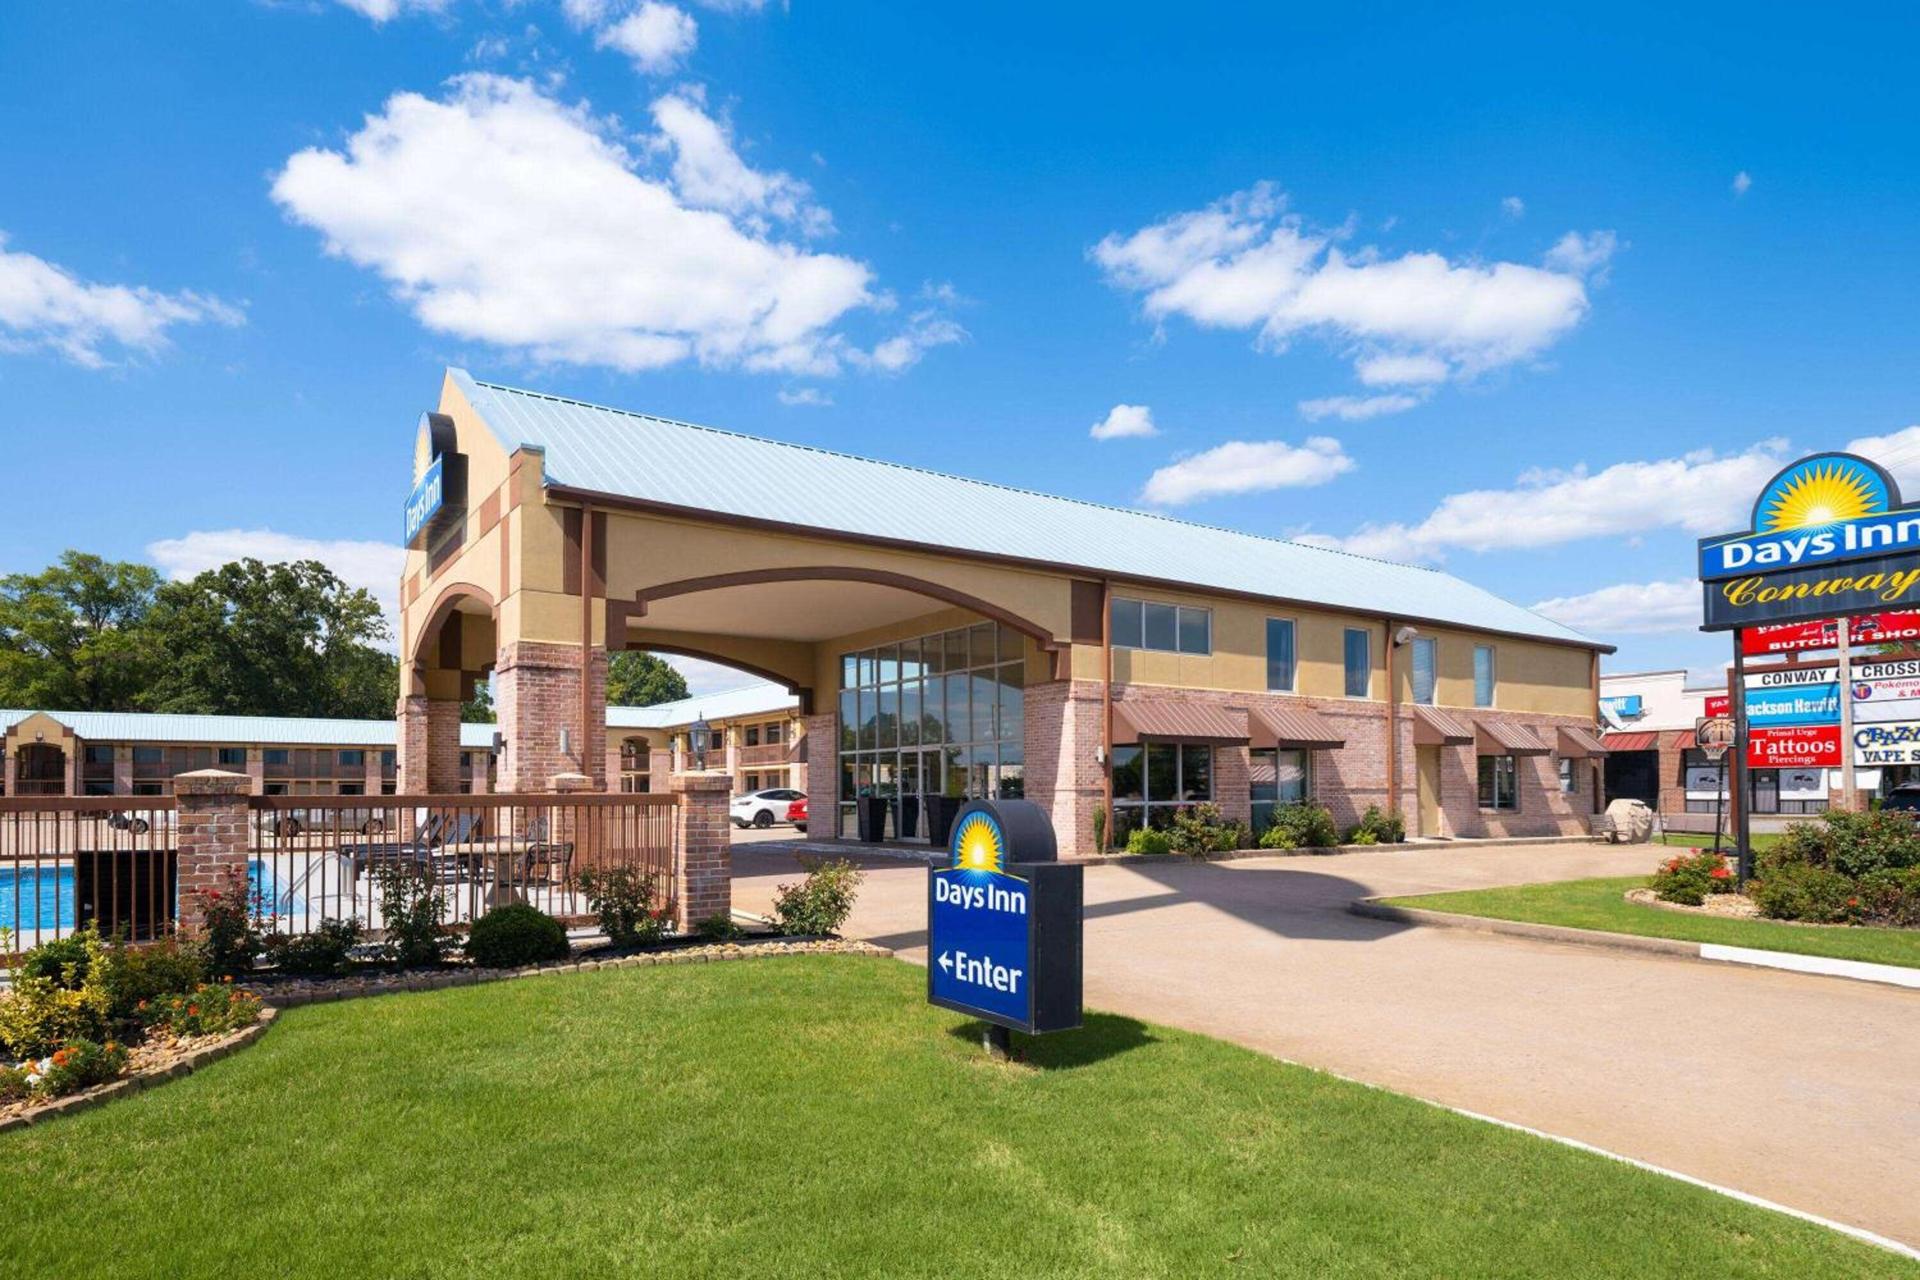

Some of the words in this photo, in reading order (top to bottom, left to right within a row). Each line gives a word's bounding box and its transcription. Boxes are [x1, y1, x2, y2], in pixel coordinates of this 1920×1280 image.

[424, 474, 440, 515] Inn
[1723, 533, 1835, 568] Days
[1845, 518, 1920, 550] Inn
[1723, 568, 1920, 606] Conway
[1769, 634, 1864, 650] BUTCHR
[1872, 629, 1920, 640] SHO
[1762, 669, 1827, 686] CONWAY
[1745, 700, 1793, 716] ackson
[1794, 696, 1839, 714] Hewitt
[1750, 738, 1836, 755] Tattoos
[1862, 750, 1905, 763] VAPE
[1768, 755, 1817, 765] Piercings
[936, 878, 984, 910] Days
[988, 882, 1026, 914] Inn
[955, 951, 1022, 993] Enter
